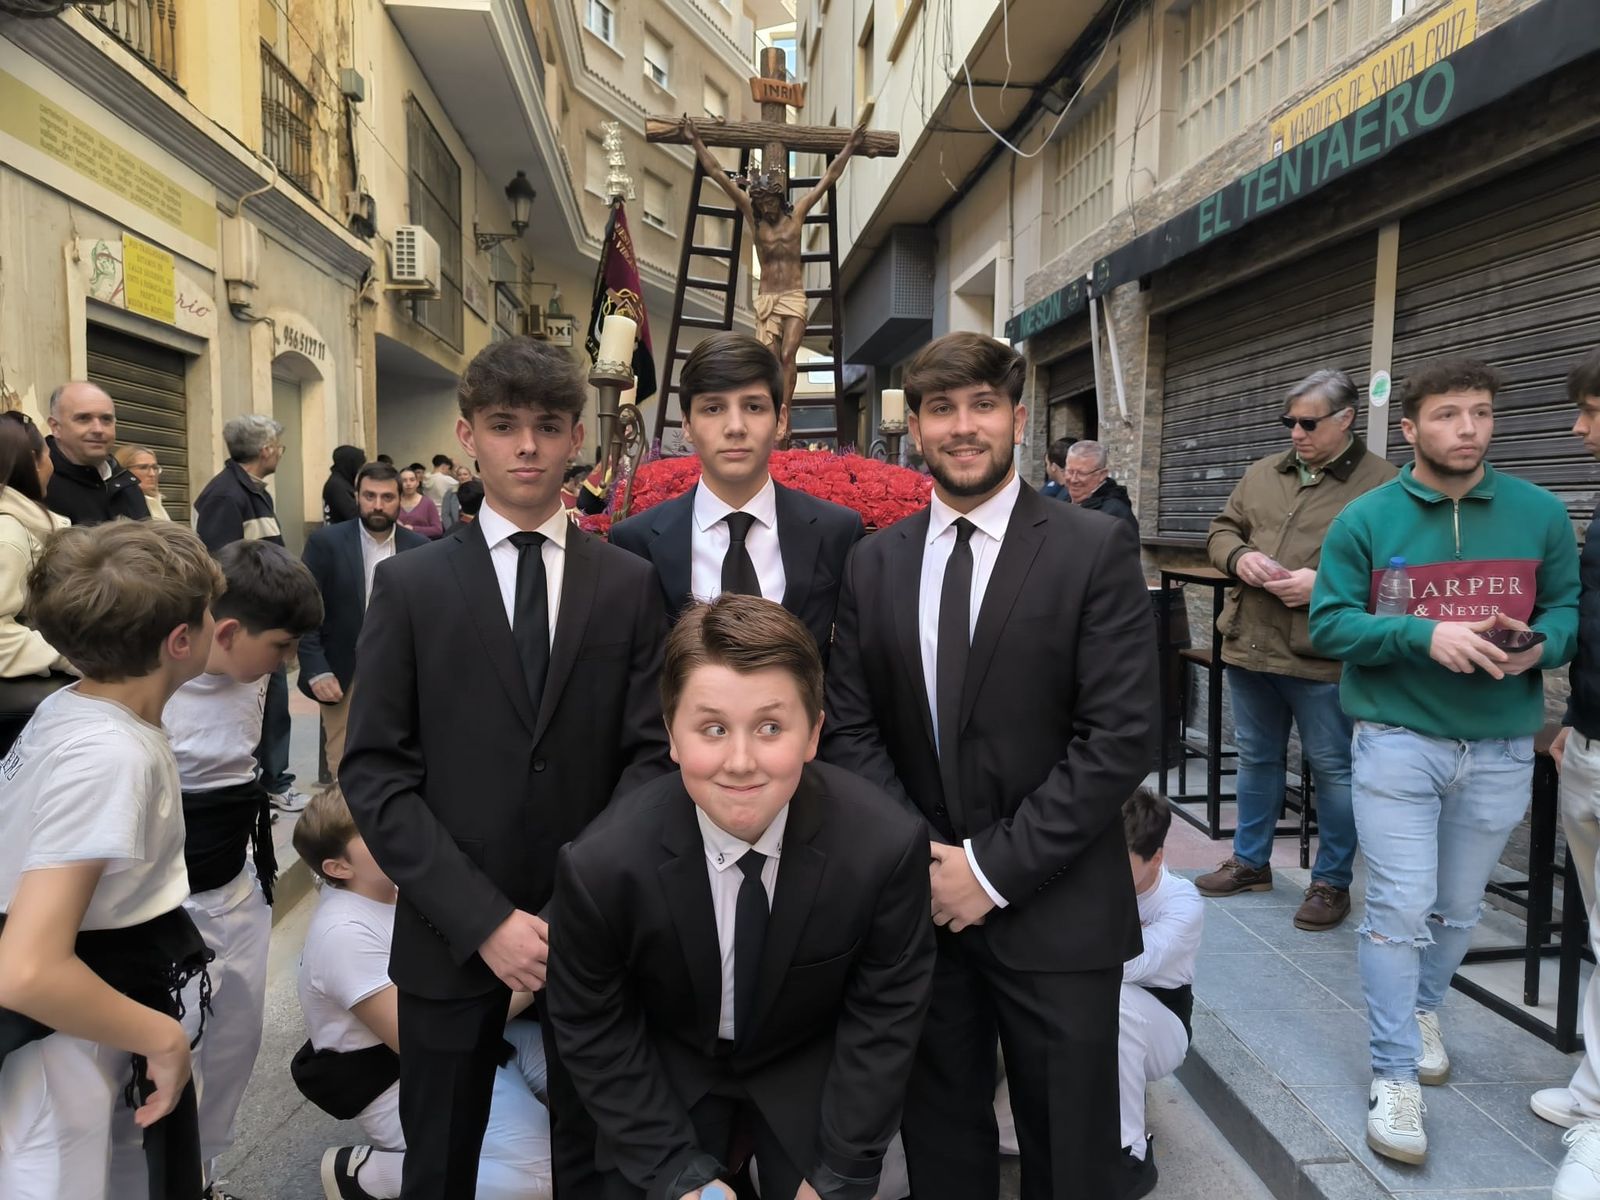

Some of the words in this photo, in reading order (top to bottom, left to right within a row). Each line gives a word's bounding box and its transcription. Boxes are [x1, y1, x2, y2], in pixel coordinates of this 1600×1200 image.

[1370, 41, 1415, 98] SANTA
[1423, 7, 1466, 69] CRUZ
[763, 83, 793, 100] INRI
[1198, 190, 1232, 243] EL
[1240, 59, 1456, 194] TENTAERO
[1413, 603, 1430, 617] &
[1439, 602, 1503, 617] NEYER
